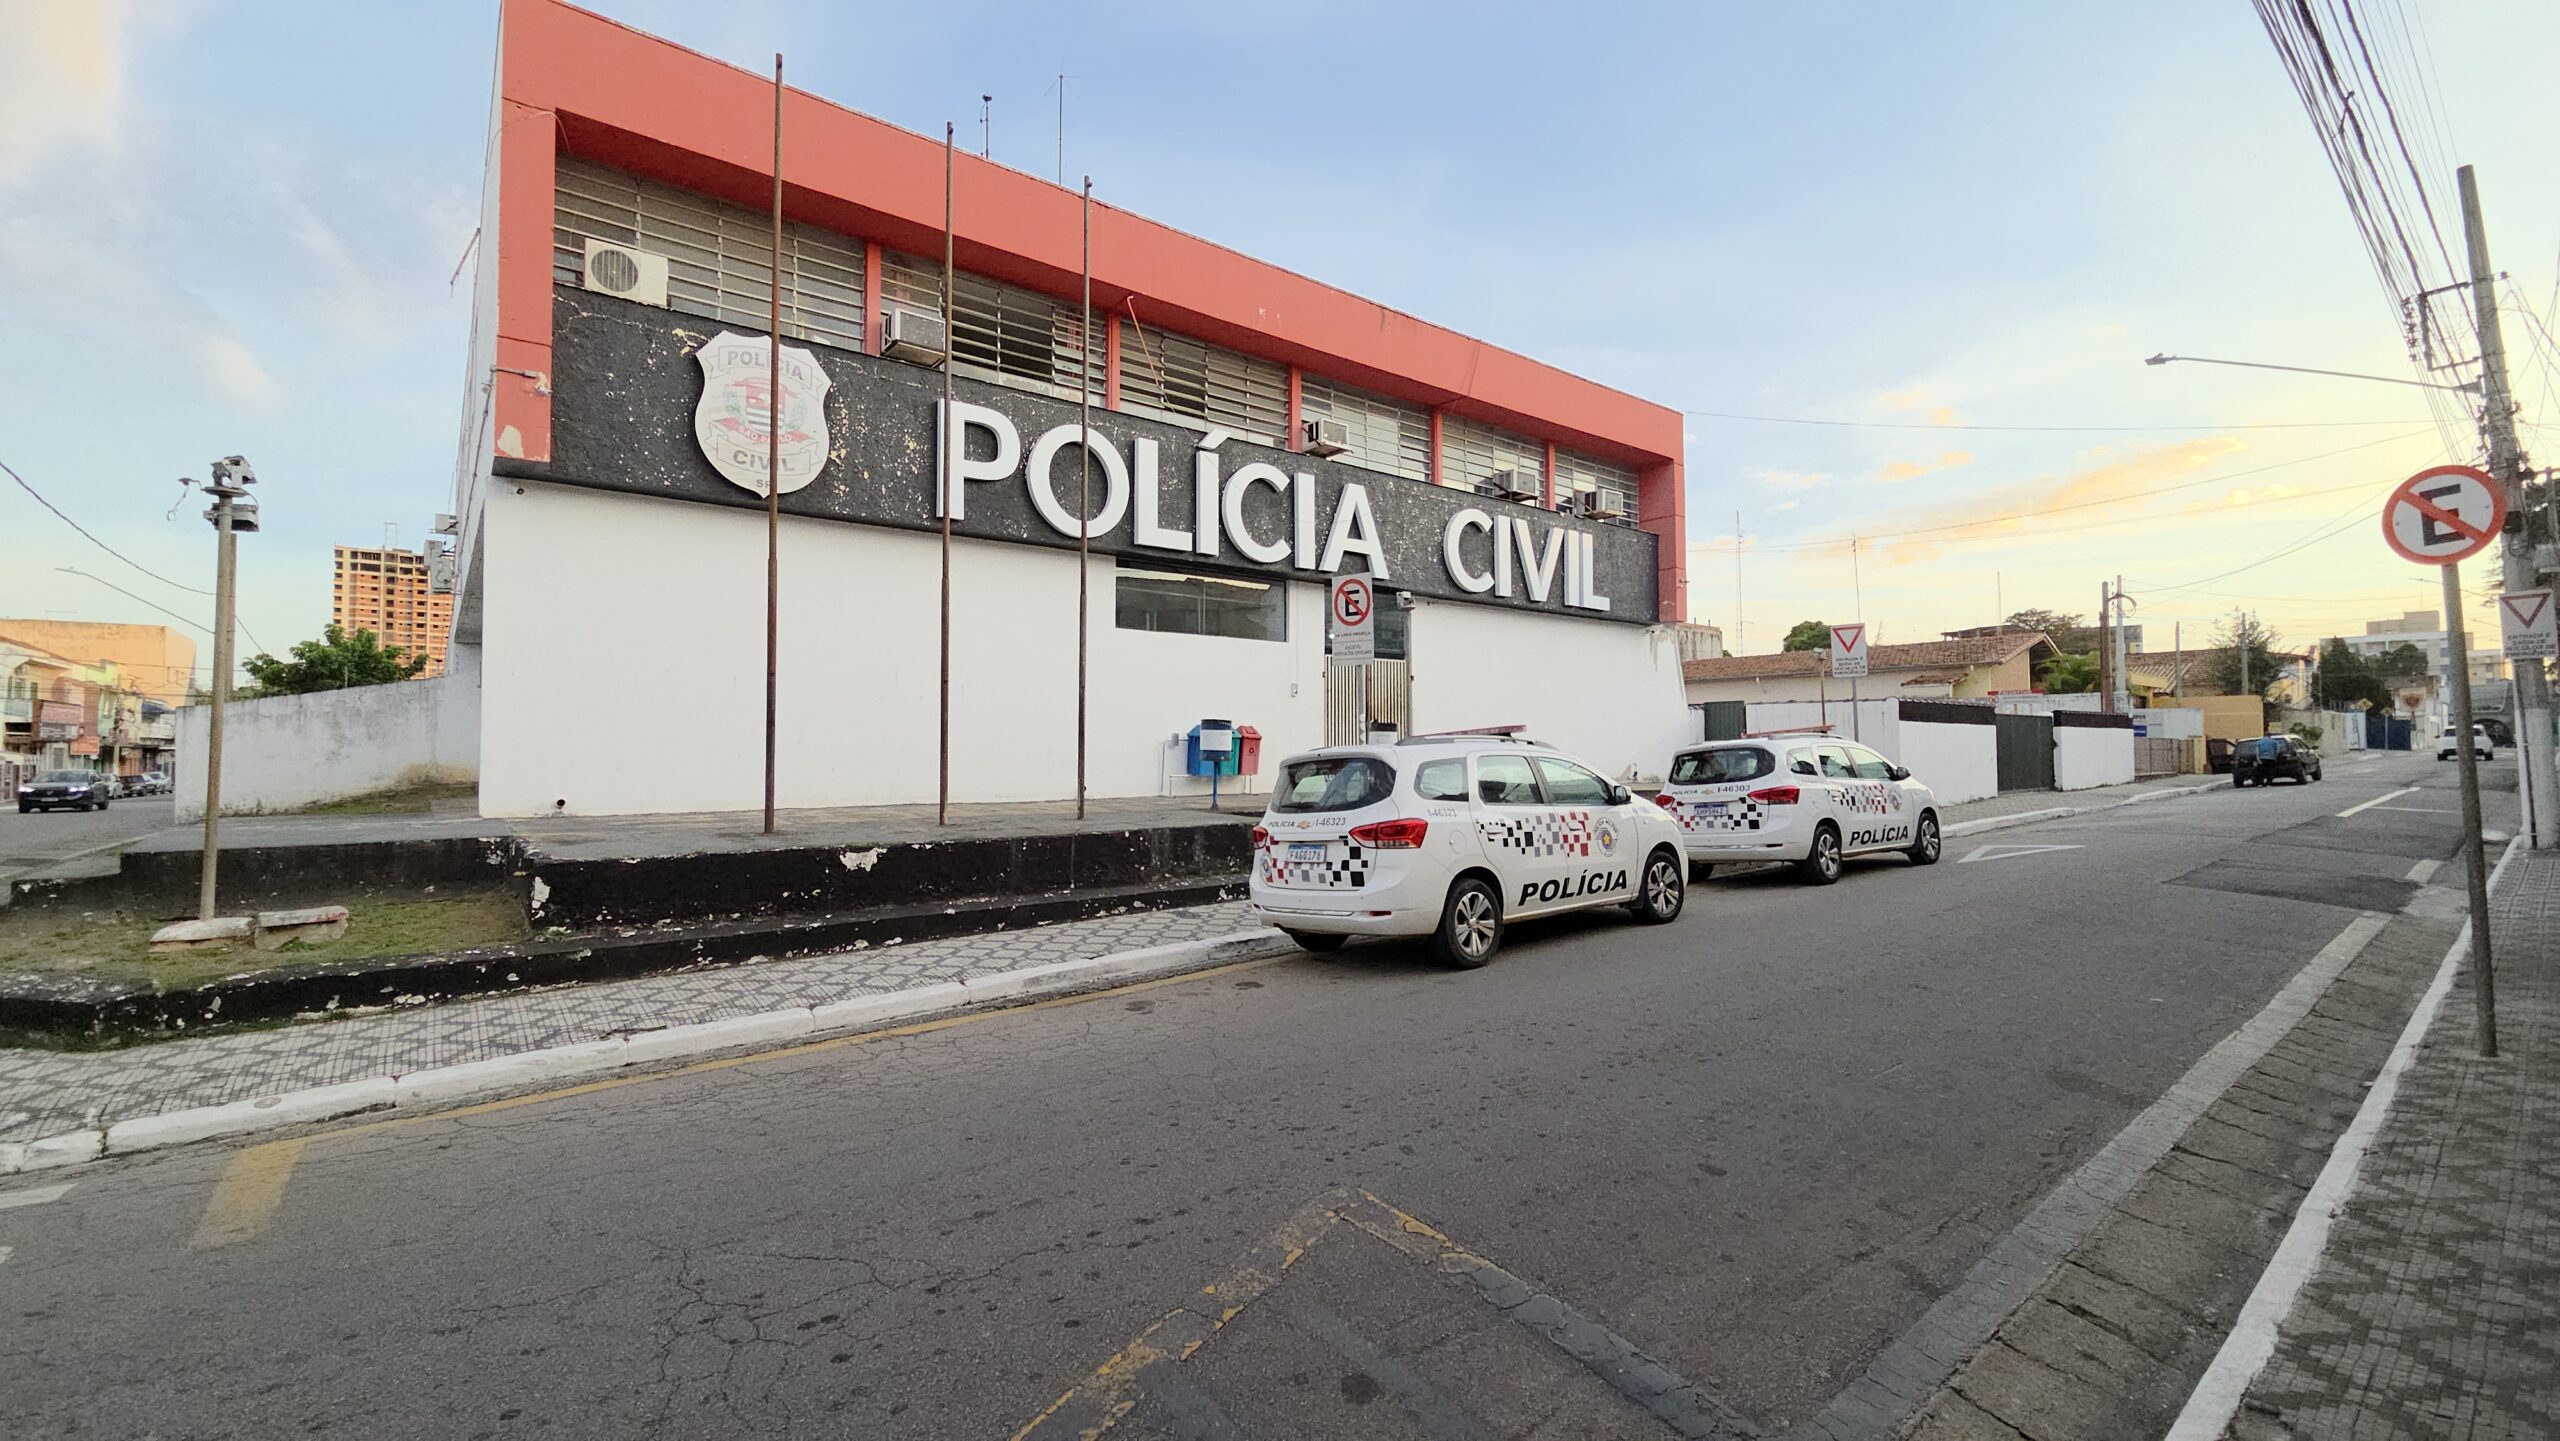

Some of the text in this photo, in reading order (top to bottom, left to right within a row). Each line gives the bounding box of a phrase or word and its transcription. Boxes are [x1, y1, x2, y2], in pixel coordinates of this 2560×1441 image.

[733, 450, 796, 472] CIVL
[936, 398, 1389, 580] POLÍCIA
[1443, 508, 1610, 611] CIVIL
[1268, 819, 1296, 828] POLÍCIA
[1849, 824, 1909, 846] POLÍCIA
[1518, 869, 1627, 907] POLÍCIA
